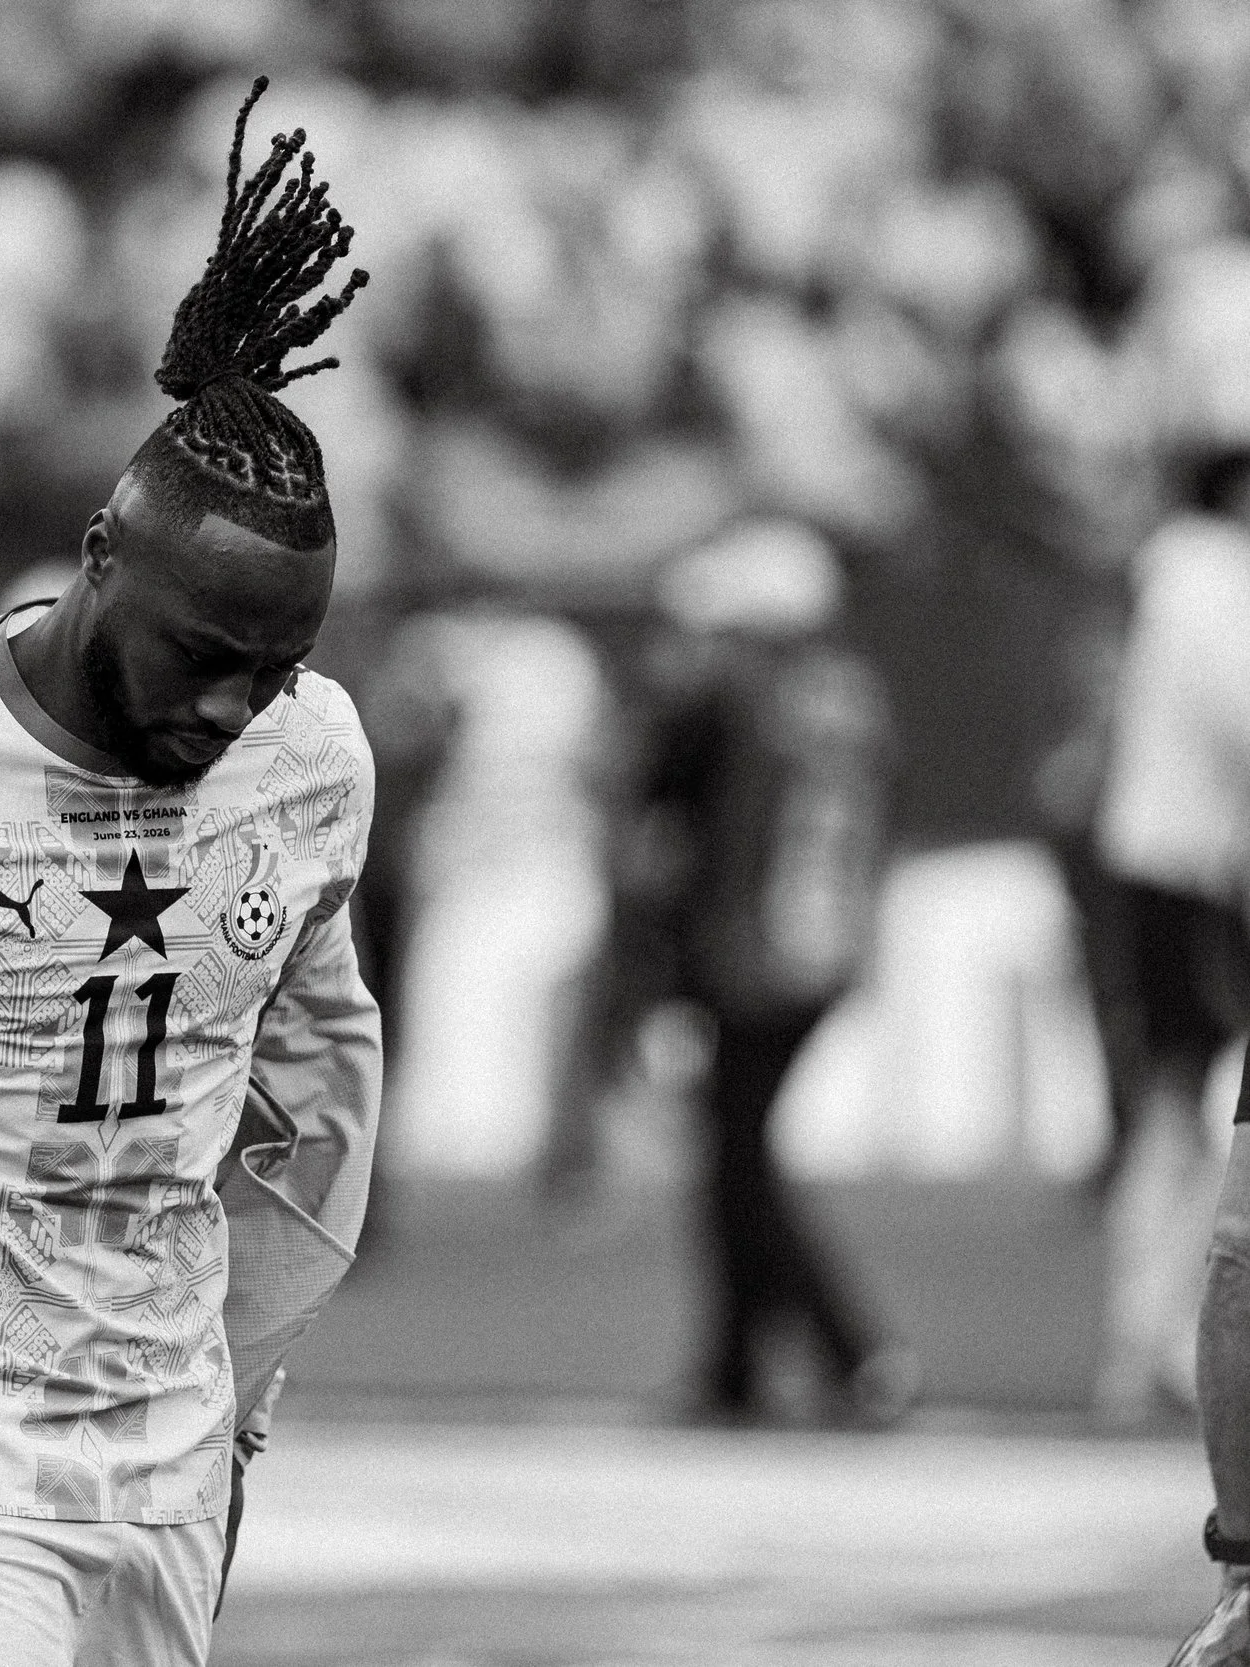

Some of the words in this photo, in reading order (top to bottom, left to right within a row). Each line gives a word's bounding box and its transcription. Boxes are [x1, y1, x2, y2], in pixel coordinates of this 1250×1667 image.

[61, 811, 120, 823] ENGLAND
[123, 810, 140, 821] VS
[143, 807, 187, 820] GHANA
[93, 832, 122, 841] June
[124, 830, 141, 840] 23,
[143, 828, 170, 838] 2026
[220, 913, 232, 944] GHANA
[229, 942, 261, 960] FOOTBALL
[57, 972, 182, 1123] 11
